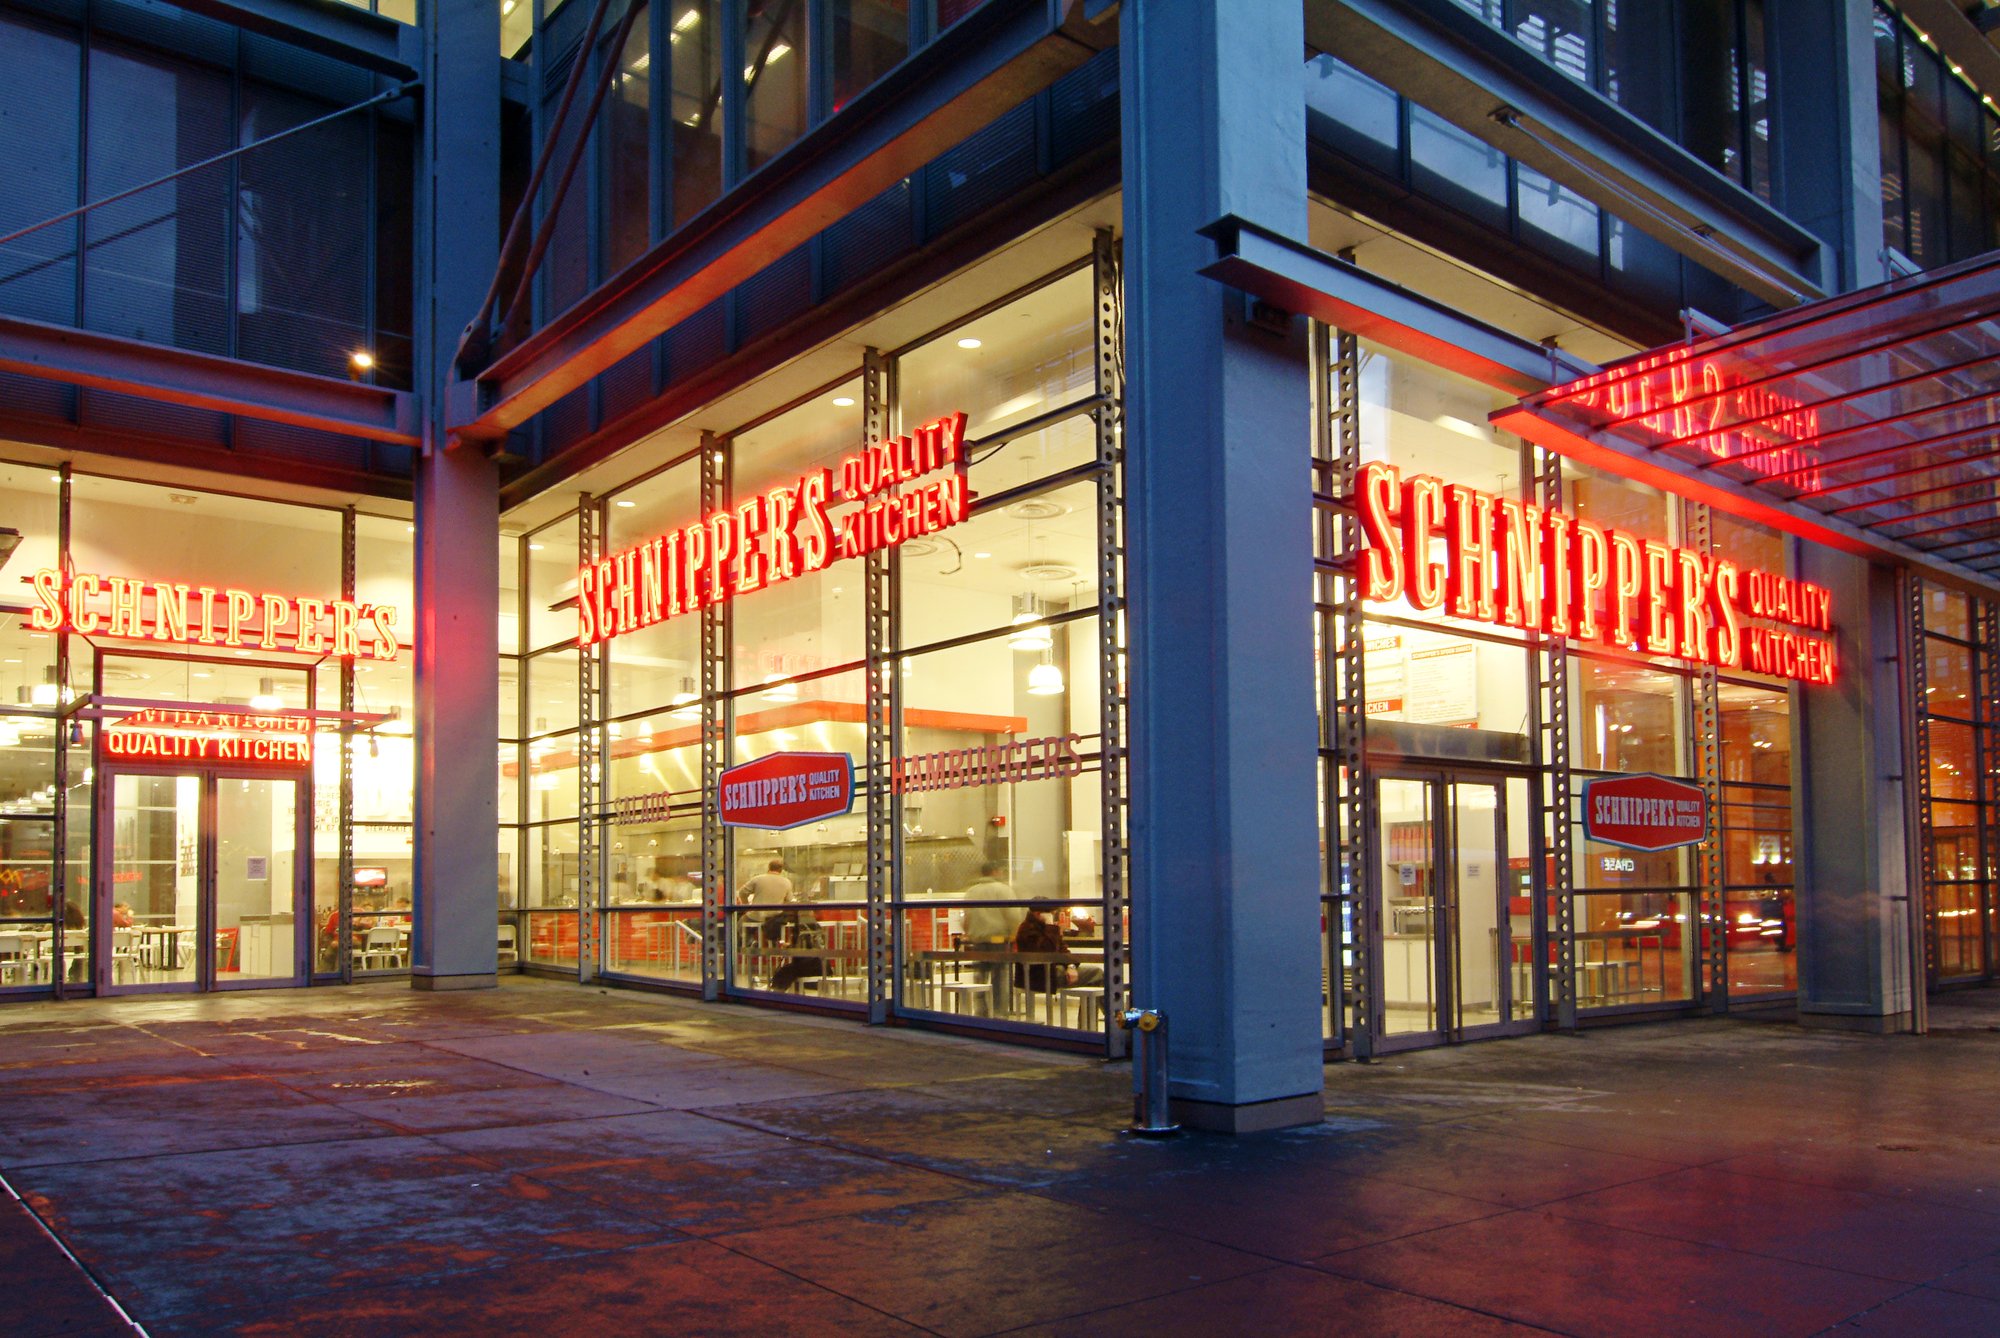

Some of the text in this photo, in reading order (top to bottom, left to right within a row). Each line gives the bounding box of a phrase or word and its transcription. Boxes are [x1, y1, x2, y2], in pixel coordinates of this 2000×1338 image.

[841, 410, 968, 500] QUALITY
[841, 474, 968, 559] KITCHEN
[578, 468, 834, 647] SCHNIPPER'S
[1355, 461, 1741, 668] SCHNIPPER'S
[32, 568, 398, 660] SCHNIPPER'S
[1740, 569, 1832, 632] QUALITY
[1741, 627, 1834, 685] KITCHEN
[108, 731, 311, 761] QUALITY KITCHEN
[891, 733, 1082, 795] HAMBURGERS
[725, 773, 807, 811] SCHNIPPER'S
[808, 769, 840, 786] QUALITY
[809, 785, 840, 801] KITCHEN
[613, 790, 670, 826] SALADS
[1595, 795, 1675, 827] SCHNIPPER'S
